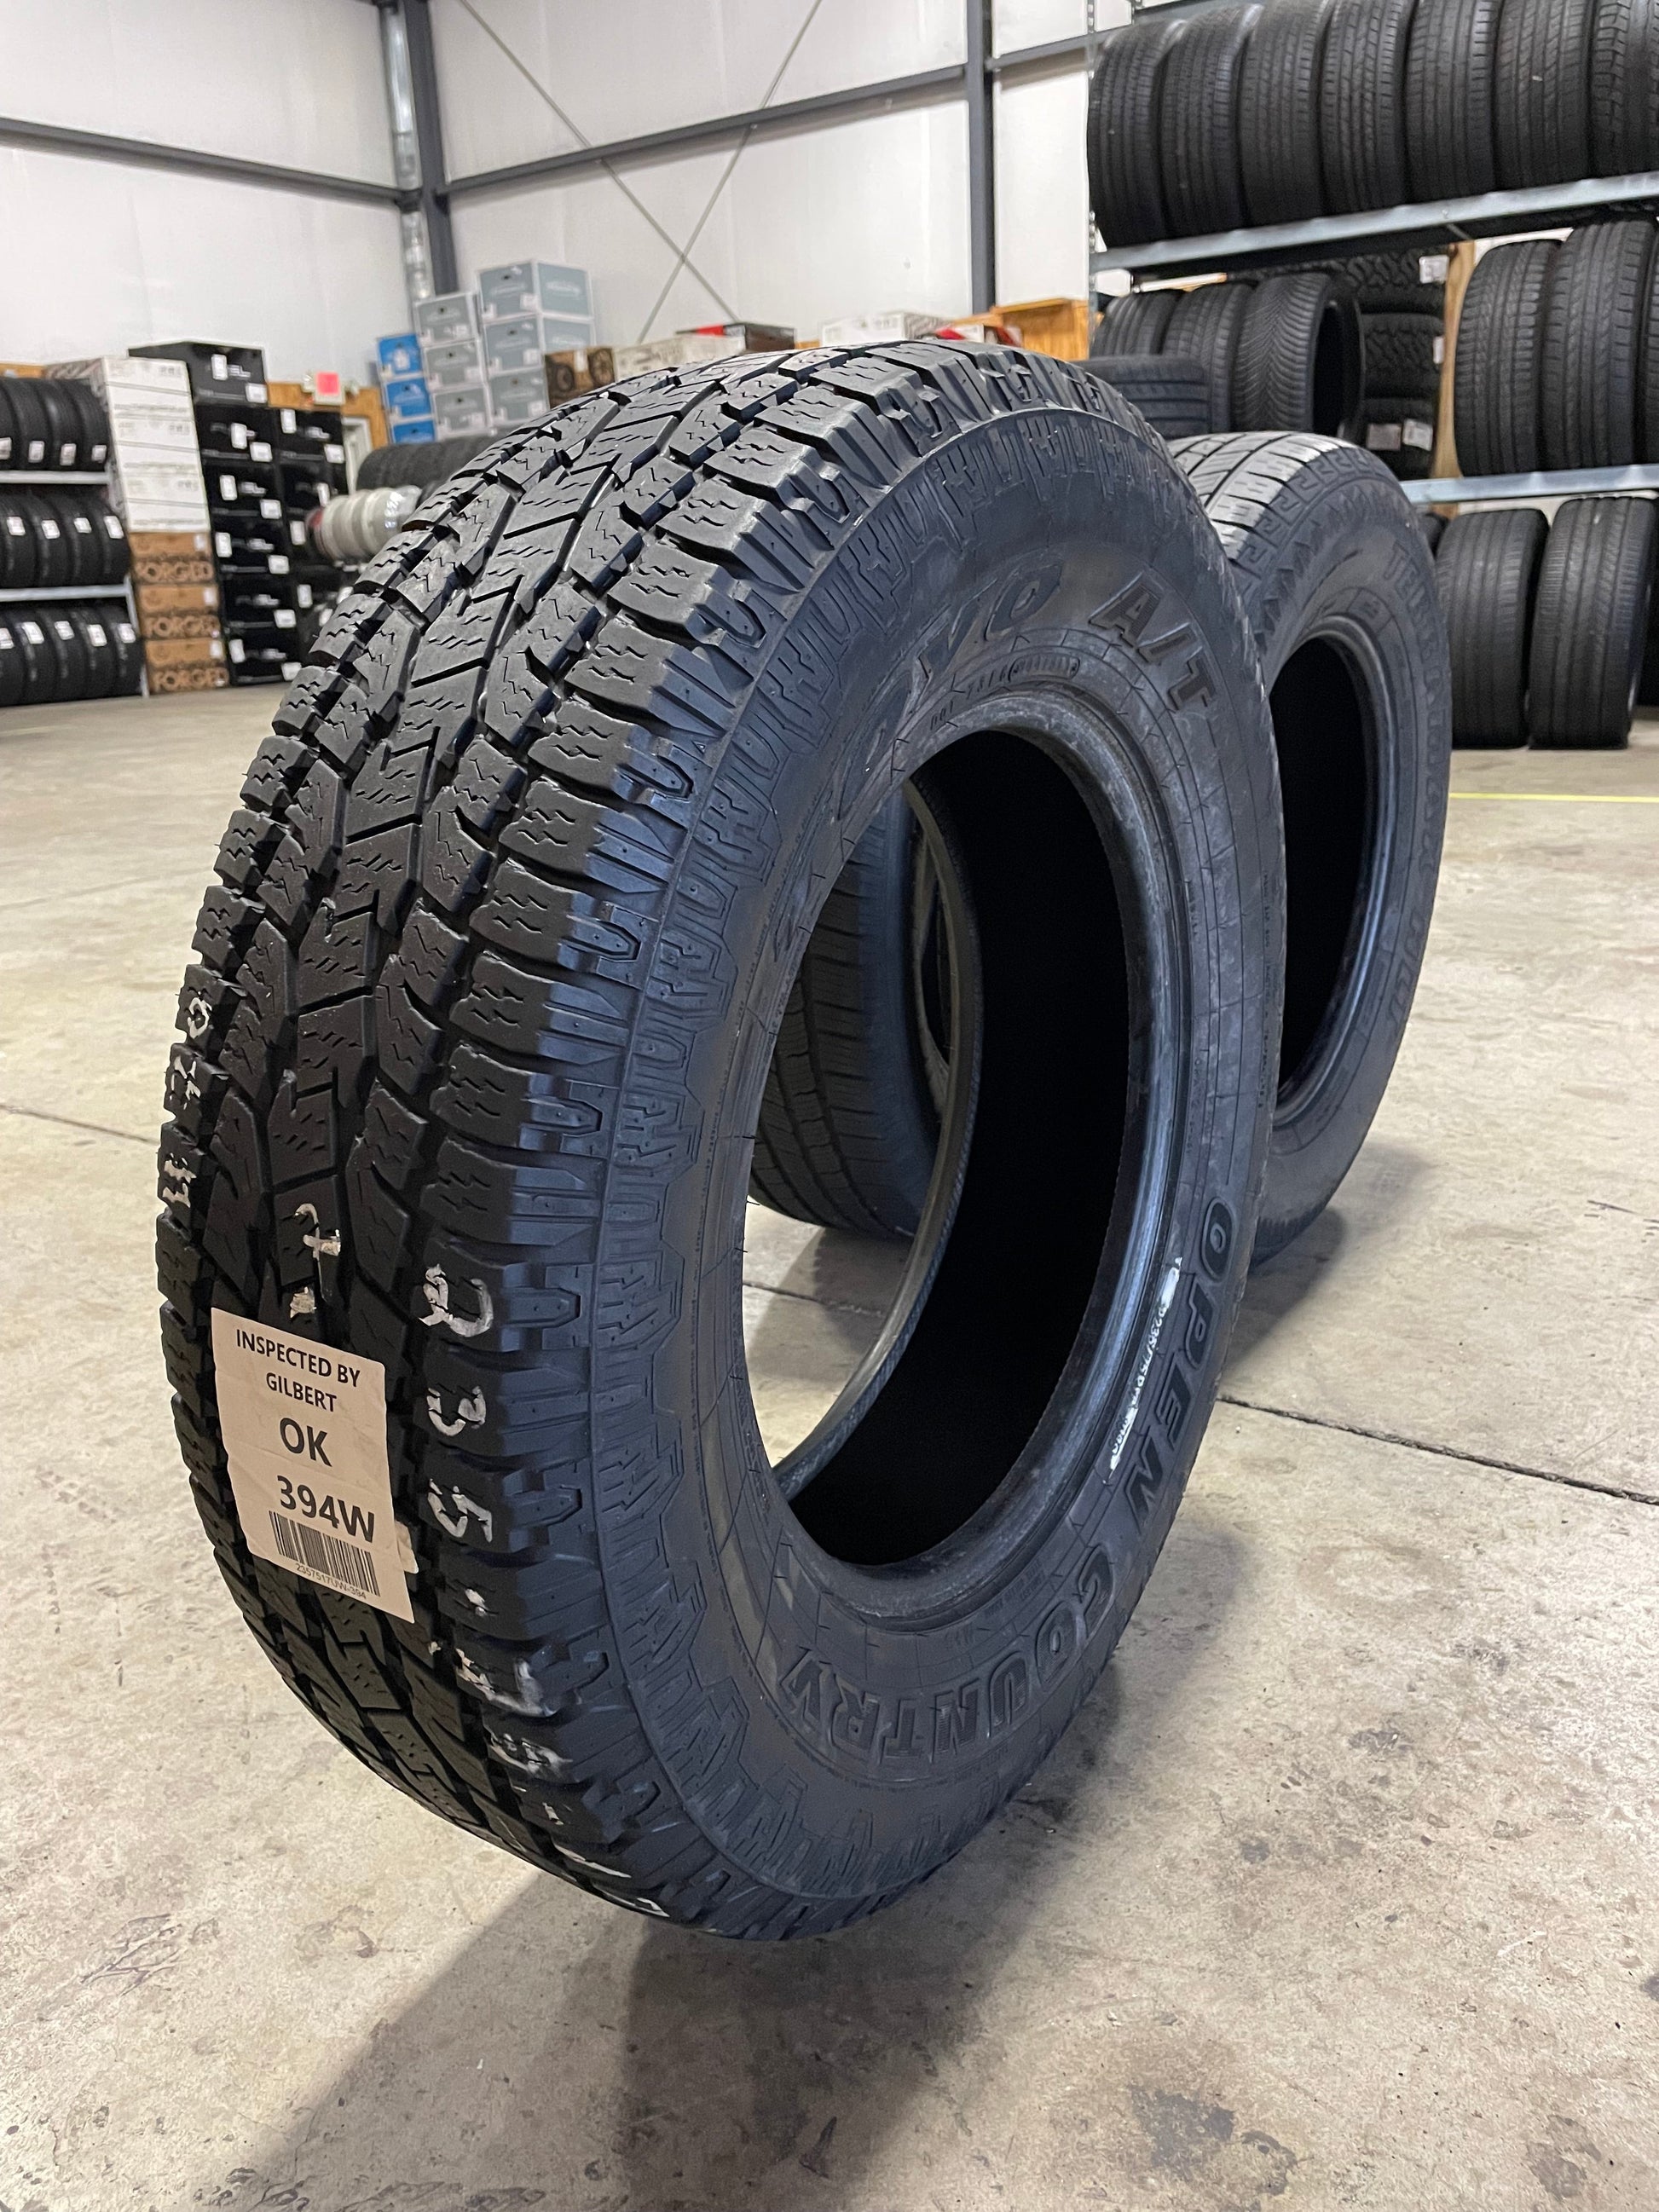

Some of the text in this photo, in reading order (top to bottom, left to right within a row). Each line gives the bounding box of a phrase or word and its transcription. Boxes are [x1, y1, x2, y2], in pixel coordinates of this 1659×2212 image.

[1088, 572, 1217, 711] A/T
[235, 1328, 361, 1388] INSPECTED BY
[265, 1372, 338, 1412] GILBERT
[279, 1417, 333, 1468] OK
[276, 1475, 375, 1544] 394W
[779, 1195, 1237, 1764] OPEN COUNTRY
